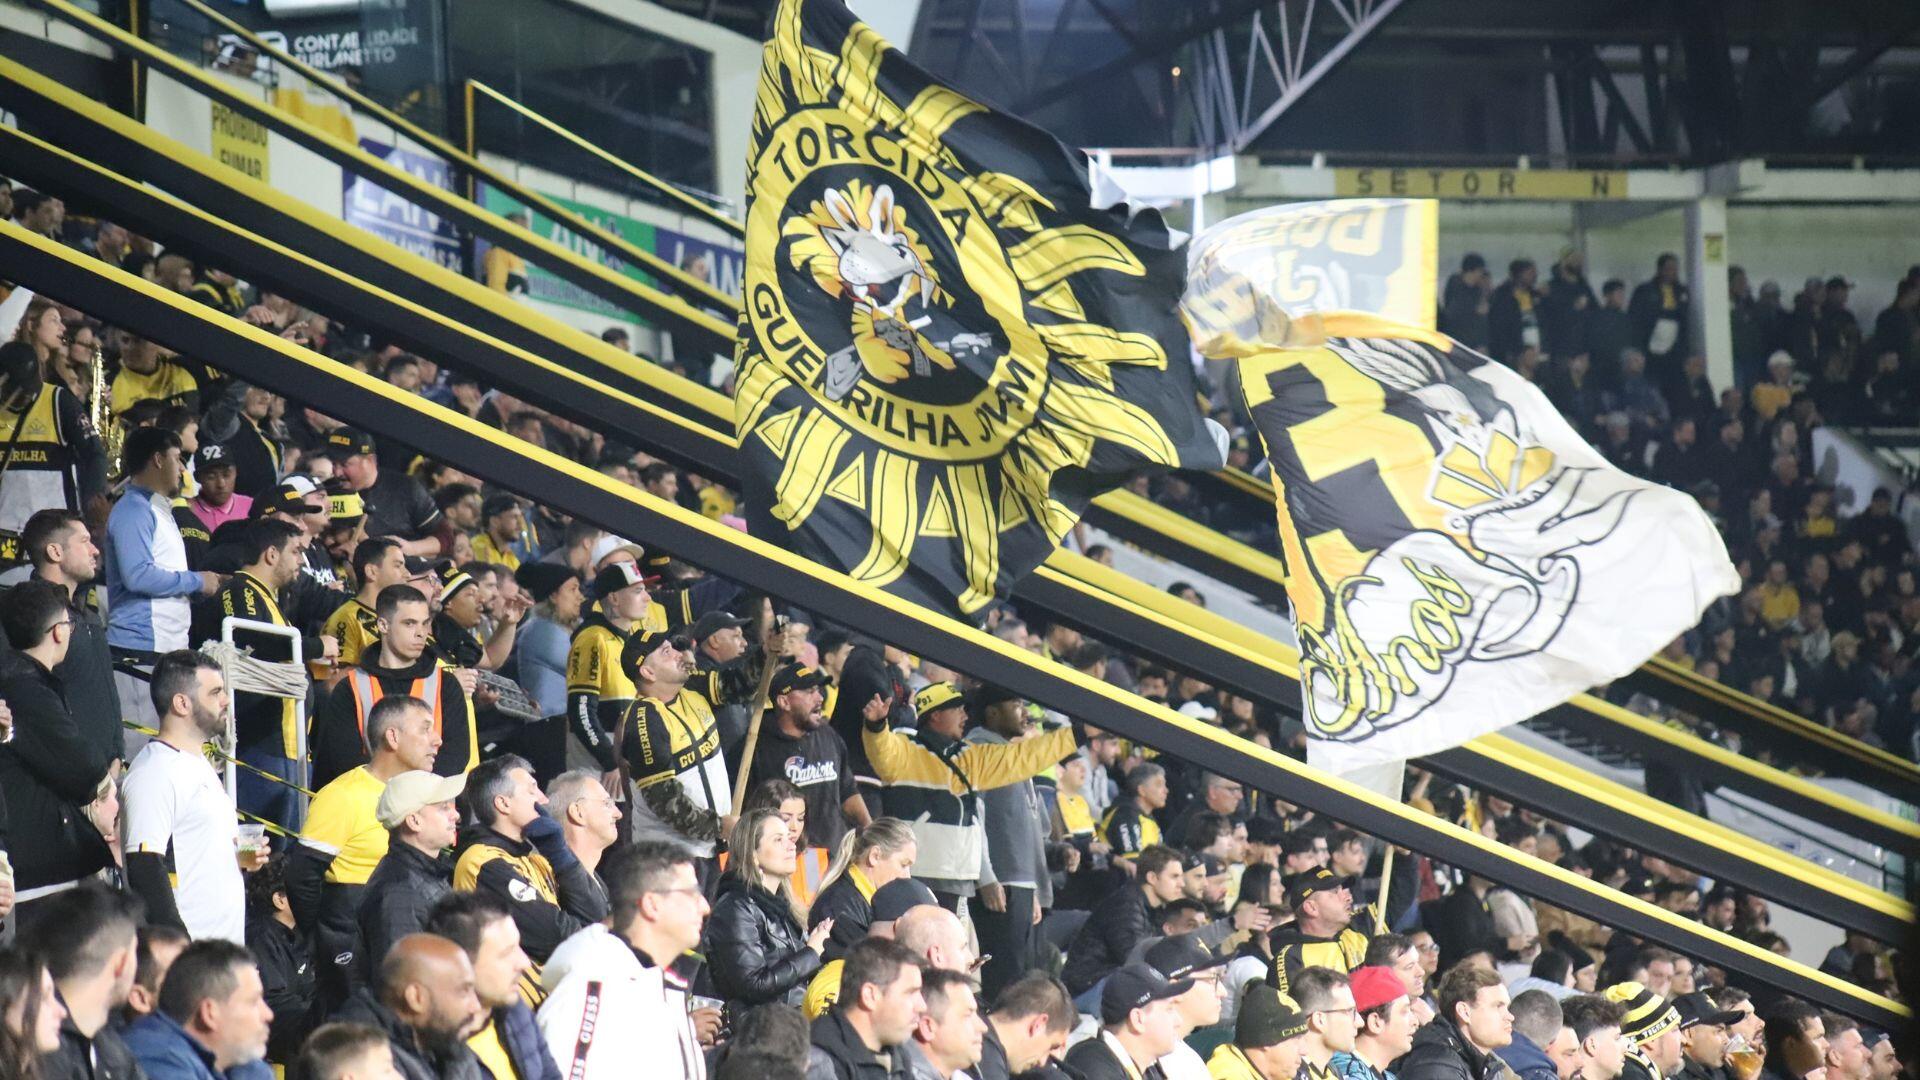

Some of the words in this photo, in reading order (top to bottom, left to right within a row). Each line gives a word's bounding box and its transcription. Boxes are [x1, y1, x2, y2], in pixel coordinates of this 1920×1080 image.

[293, 27, 418, 52] CONTABLIDADE
[774, 122, 970, 246] TORCIDA
[1357, 169, 1515, 194] SETOR
[1592, 175, 1609, 196] N
[202, 445, 223, 461] 92
[786, 760, 838, 787] Patriots
[580, 994, 599, 1044] GUESS
